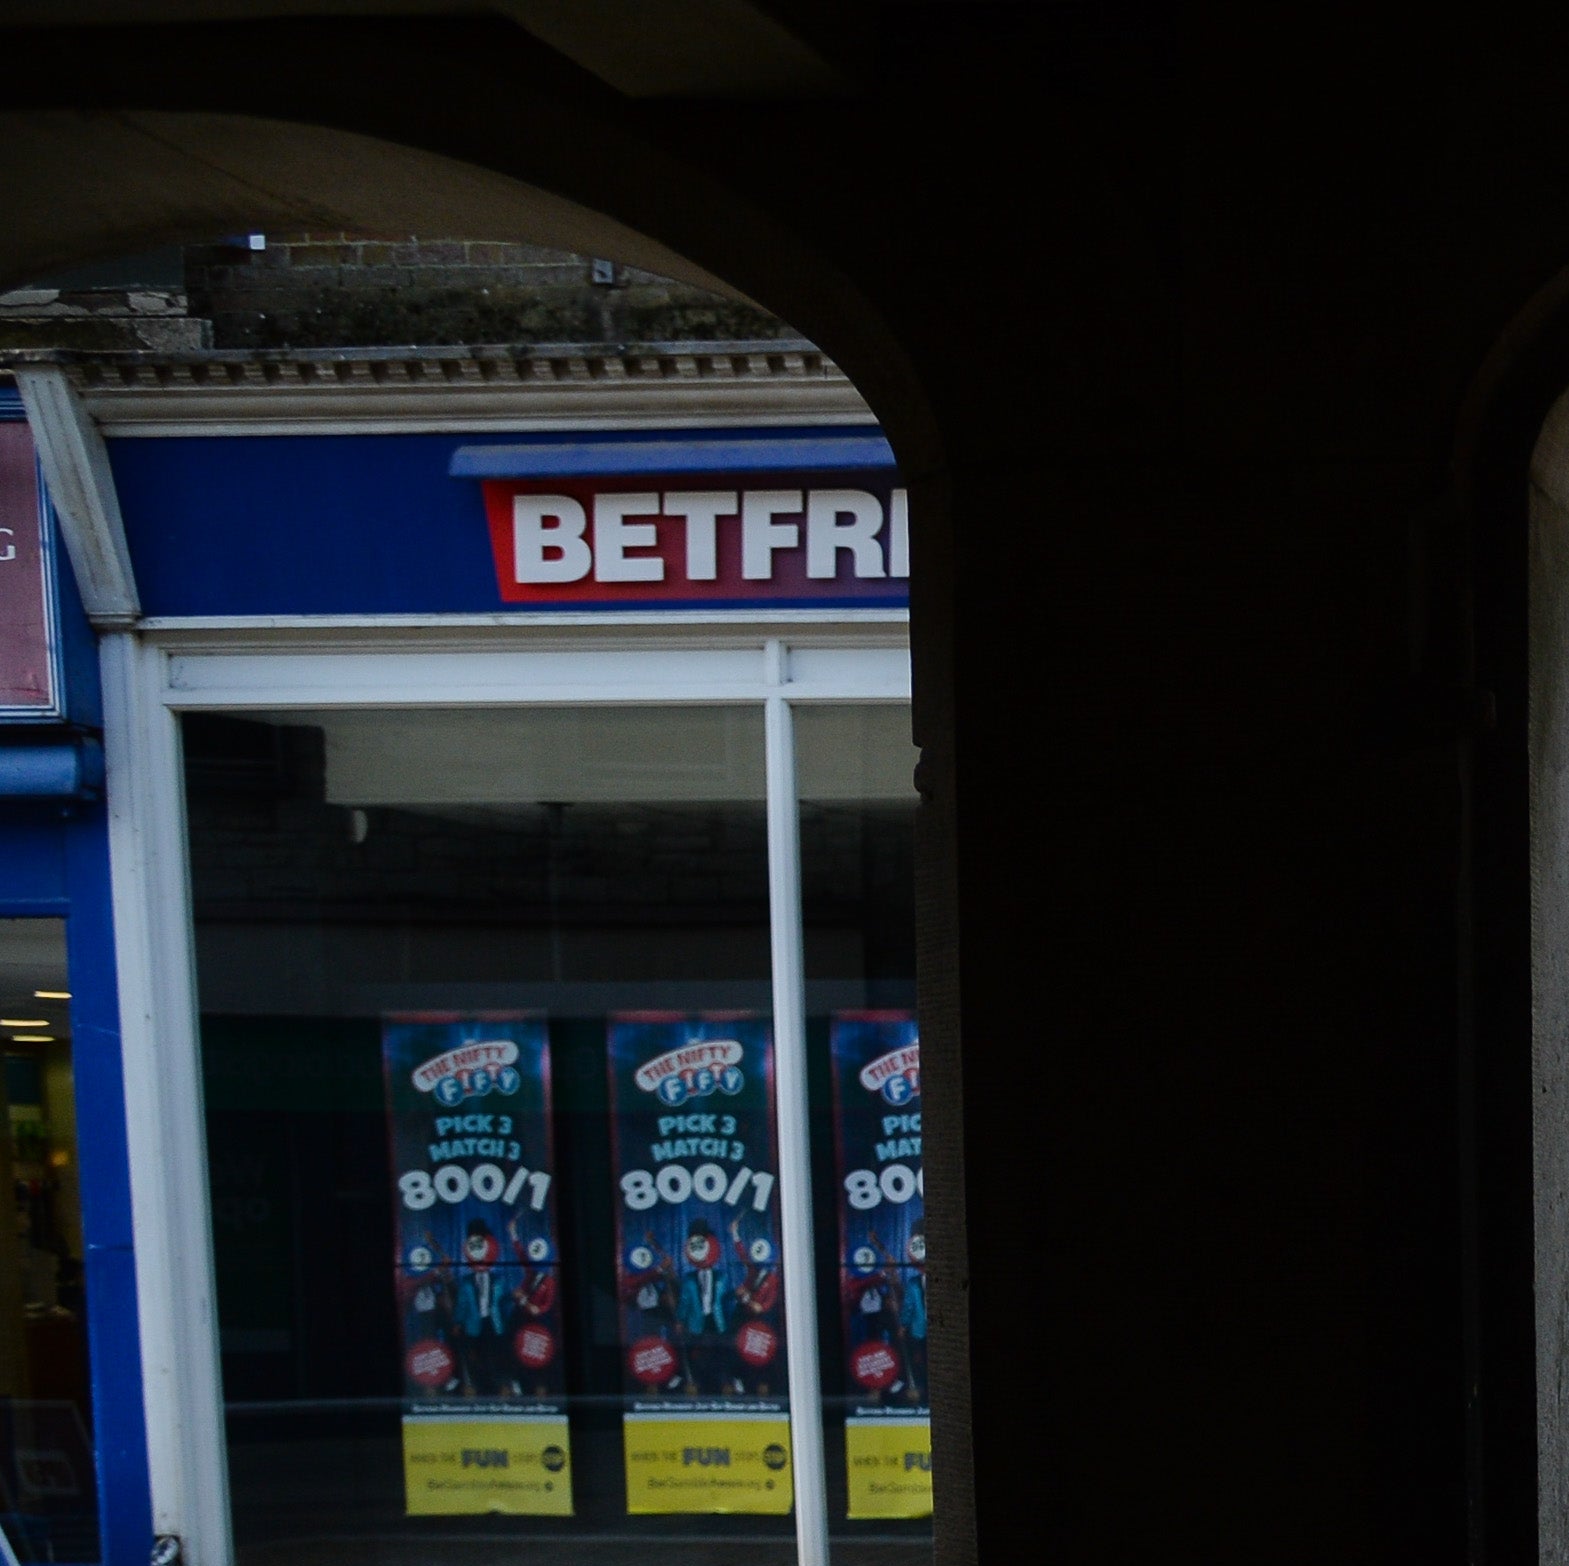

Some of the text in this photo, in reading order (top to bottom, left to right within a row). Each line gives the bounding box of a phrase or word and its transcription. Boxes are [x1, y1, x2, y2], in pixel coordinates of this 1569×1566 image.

[513, 489, 911, 584] BETFR
[420, 1047, 506, 1082] THE NIFTY
[642, 1046, 731, 1082] THE NIFTY
[868, 1059, 898, 1081] THE
[440, 1065, 516, 1101] FIFTY
[663, 1065, 739, 1101] FIFTY
[435, 1114, 513, 1136] PICK 3
[658, 1114, 736, 1136] PICK 3
[882, 1114, 921, 1136] PIC
[428, 1137, 521, 1162] MATCH 3
[651, 1137, 745, 1162] MATCH 3
[875, 1138, 922, 1162] MAT
[398, 1163, 552, 1211] 800/1
[620, 1163, 775, 1212] 800/1
[460, 1449, 509, 1468] FUN
[682, 1447, 731, 1466] FUN
[904, 1452, 932, 1471] FU
